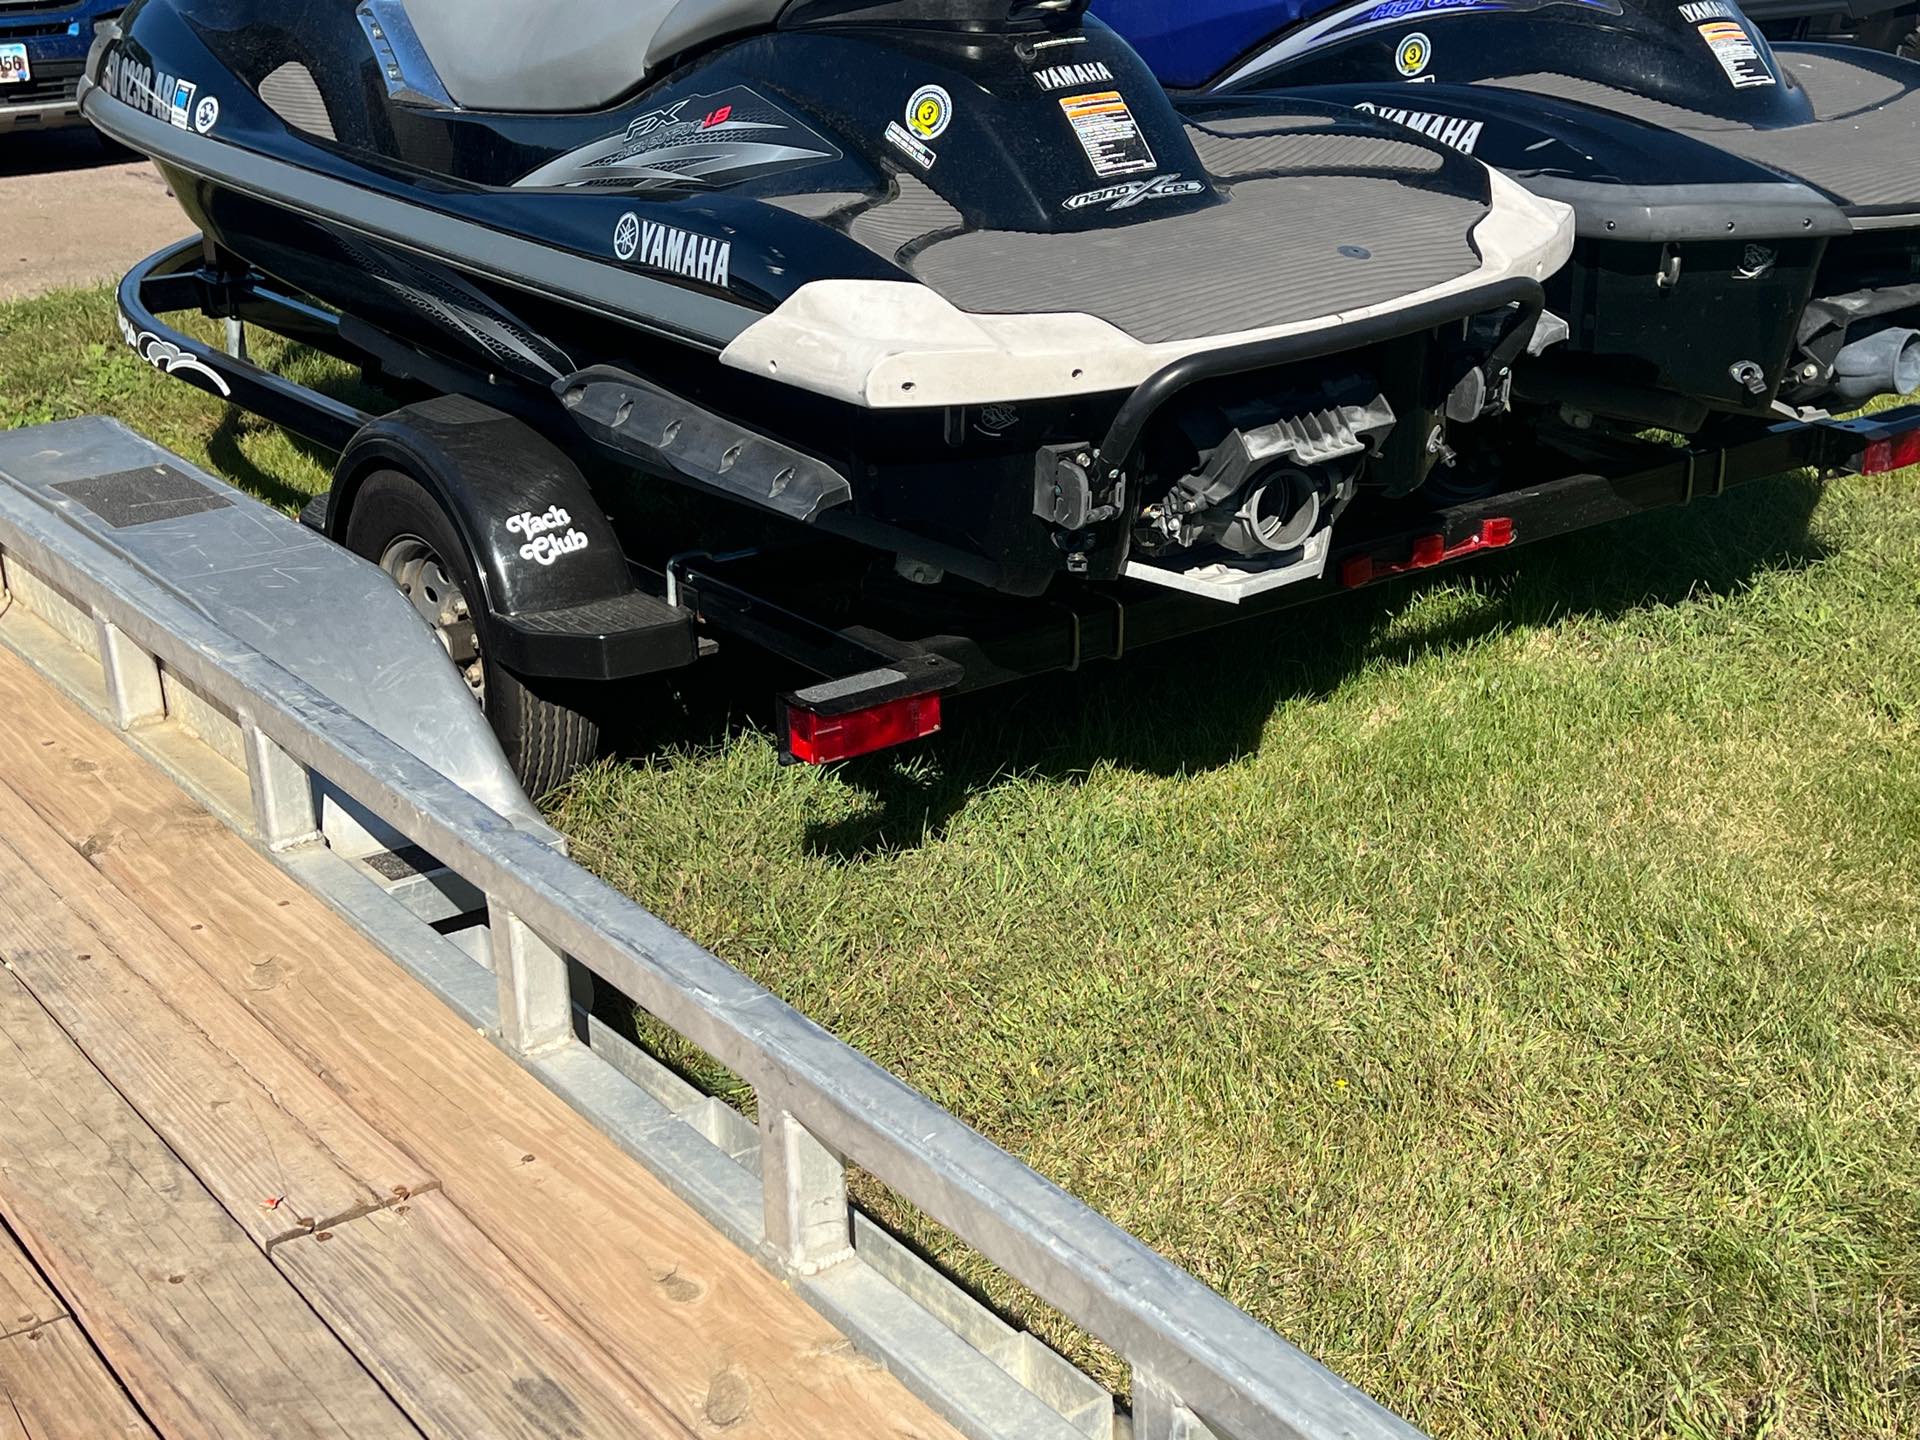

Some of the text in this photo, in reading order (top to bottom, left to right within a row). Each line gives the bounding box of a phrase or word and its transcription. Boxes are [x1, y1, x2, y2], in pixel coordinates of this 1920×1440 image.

[0, 55, 22, 71] 56
[1409, 48, 1417, 60] 3
[1034, 62, 1114, 88] YAMAHA
[624, 99, 690, 142] FX
[922, 105, 935, 121] 3
[640, 220, 730, 289] YAMAHA
[506, 505, 571, 541] Yach
[519, 528, 588, 565] Club
